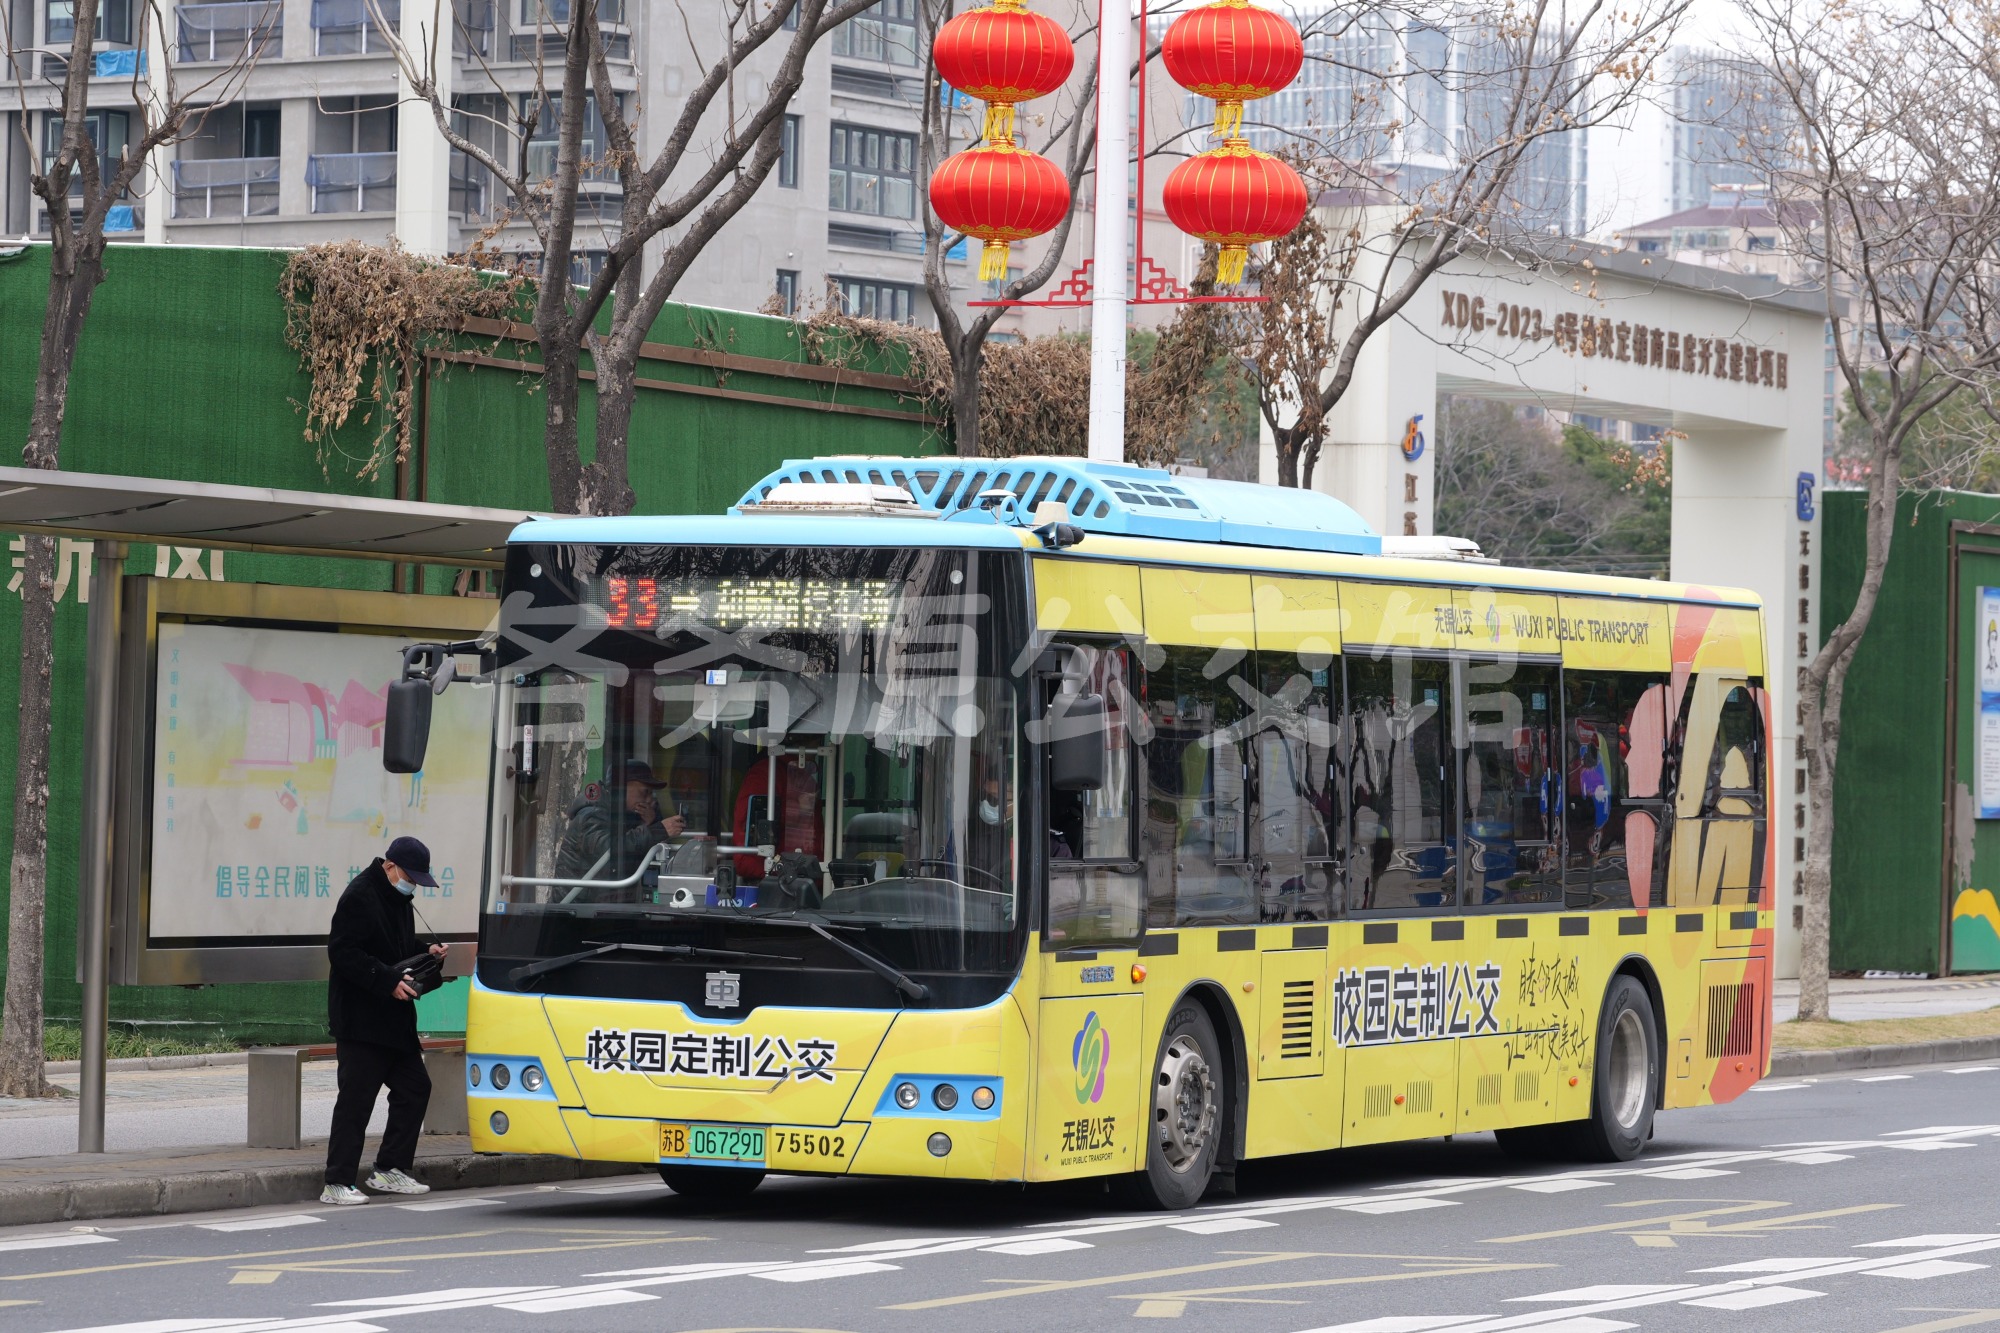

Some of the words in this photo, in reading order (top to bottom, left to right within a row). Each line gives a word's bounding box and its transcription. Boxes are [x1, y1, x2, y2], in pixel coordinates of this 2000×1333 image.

[608, 578, 657, 627] 33
[1434, 607, 1473, 636] 无锡公交
[1513, 614, 1543, 639] WUXI
[1547, 617, 1585, 641] PUBLIC
[1587, 619, 1649, 645] TRANSPORT
[216, 865, 330, 898] 倡导全民阅读
[1333, 964, 1501, 1045] 校园定制公交
[587, 1029, 835, 1082] 校园定制公交
[662, 1129, 685, 1153] 苏B
[694, 1130, 763, 1156] 06729D
[775, 1132, 845, 1158] 75502
[1061, 1116, 1115, 1152] 无锡公交
